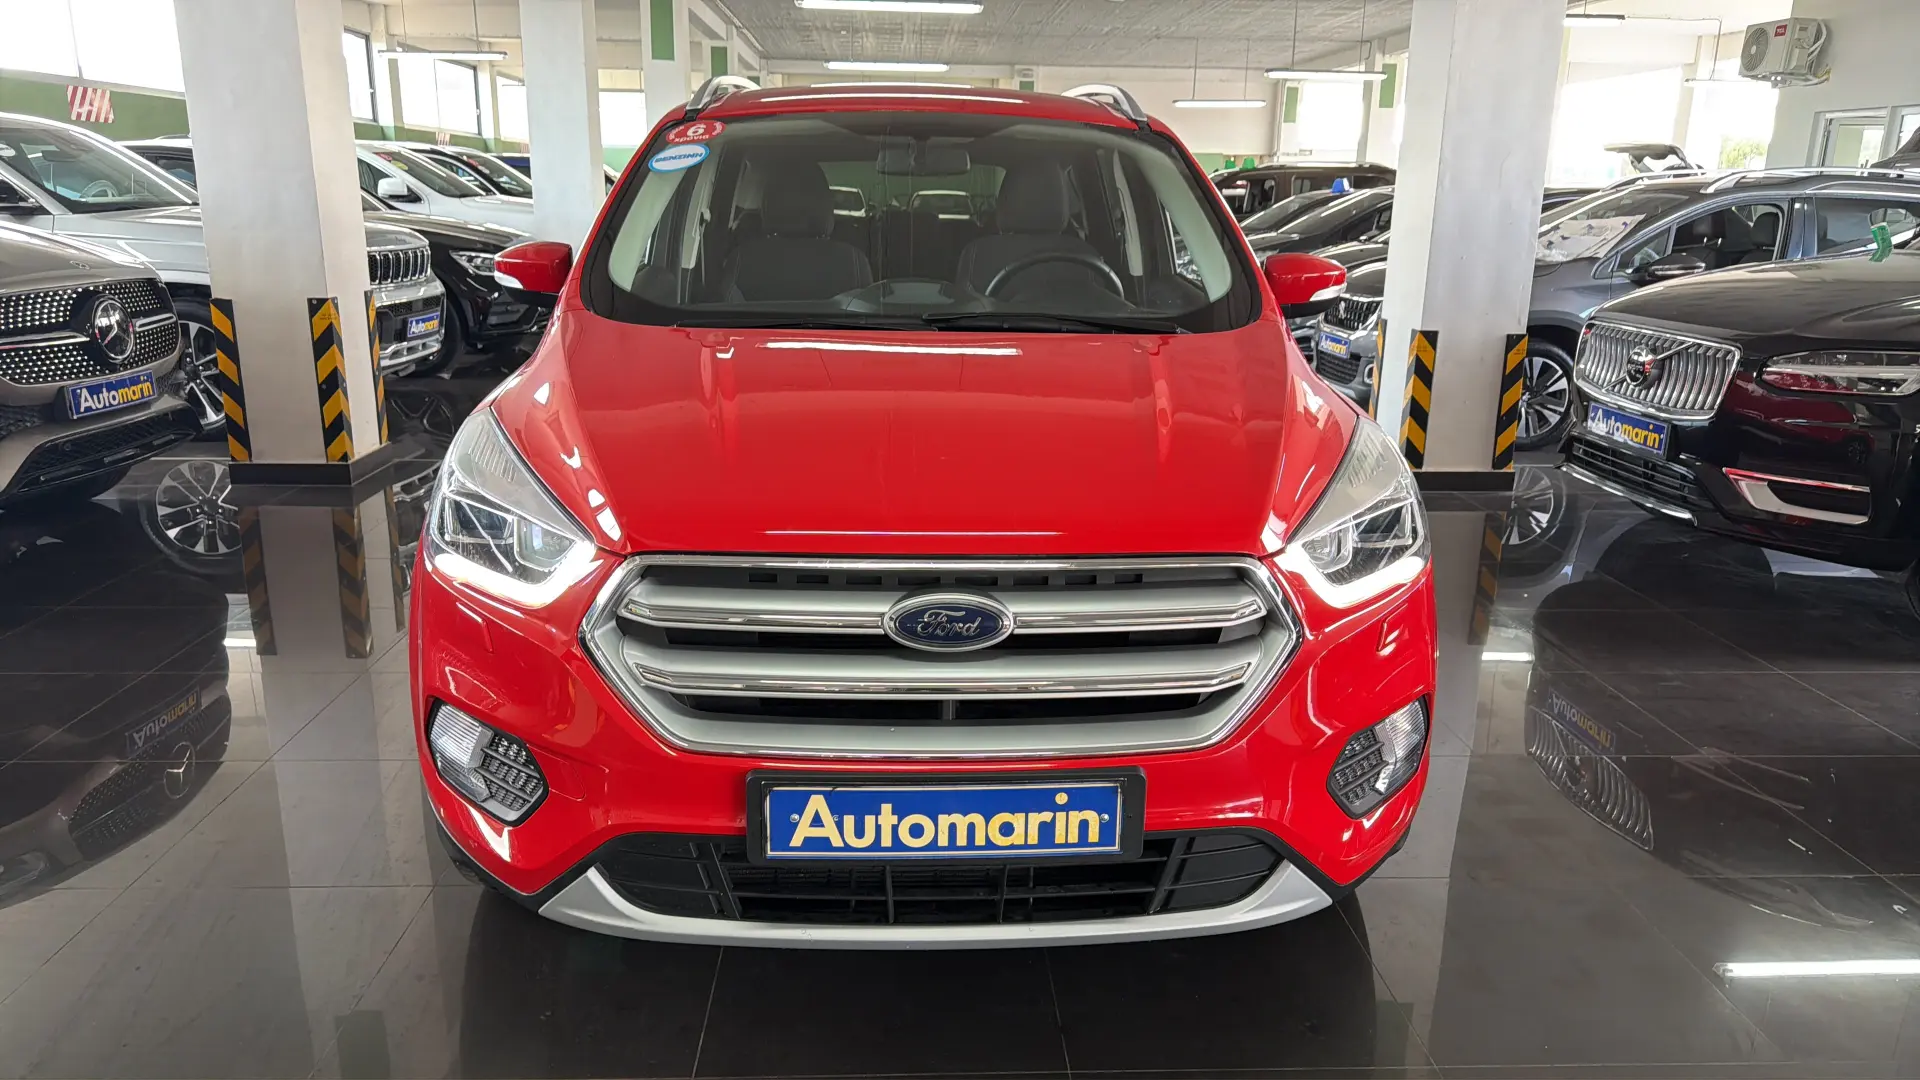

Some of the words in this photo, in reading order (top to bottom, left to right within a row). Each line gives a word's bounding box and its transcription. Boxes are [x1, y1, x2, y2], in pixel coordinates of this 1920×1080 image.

[686, 123, 706, 136] 6
[80, 375, 153, 413] Automarin
[1592, 408, 1660, 449] Automarin
[917, 609, 982, 637] Ford
[789, 792, 1100, 848] Automarin
